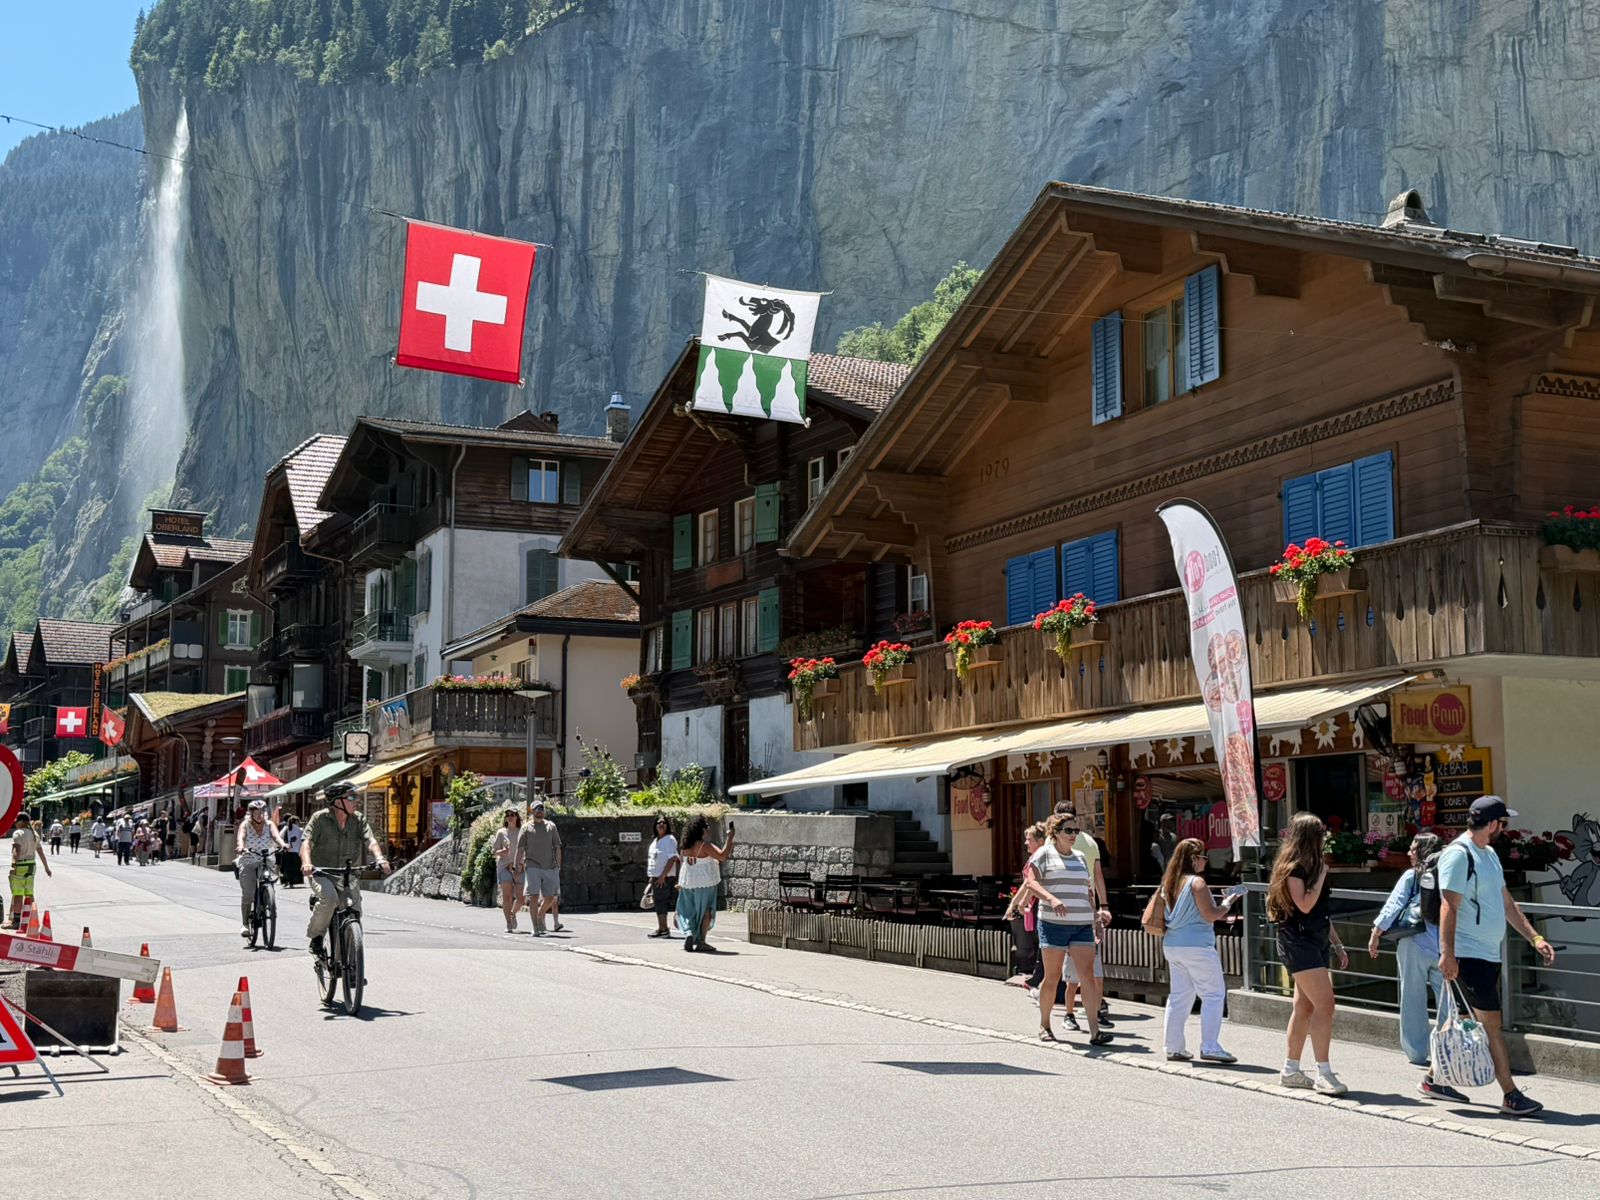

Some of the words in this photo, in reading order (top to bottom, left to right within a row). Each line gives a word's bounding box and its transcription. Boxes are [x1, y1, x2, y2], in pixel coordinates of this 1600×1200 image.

[980, 457, 1009, 483] 1979
[156, 523, 199, 533] OBERLAND
[164, 516, 190, 525] HOTEL
[92, 692, 100, 736] OBERLAND
[1400, 703, 1428, 726] Food
[1432, 703, 1464, 726] Point
[1437, 762, 1469, 776] KEBAB
[1437, 779, 1462, 792] PIZZA
[953, 795, 969, 815] Food
[1209, 812, 1230, 837] Poin
[27, 944, 54, 957] Stähli
